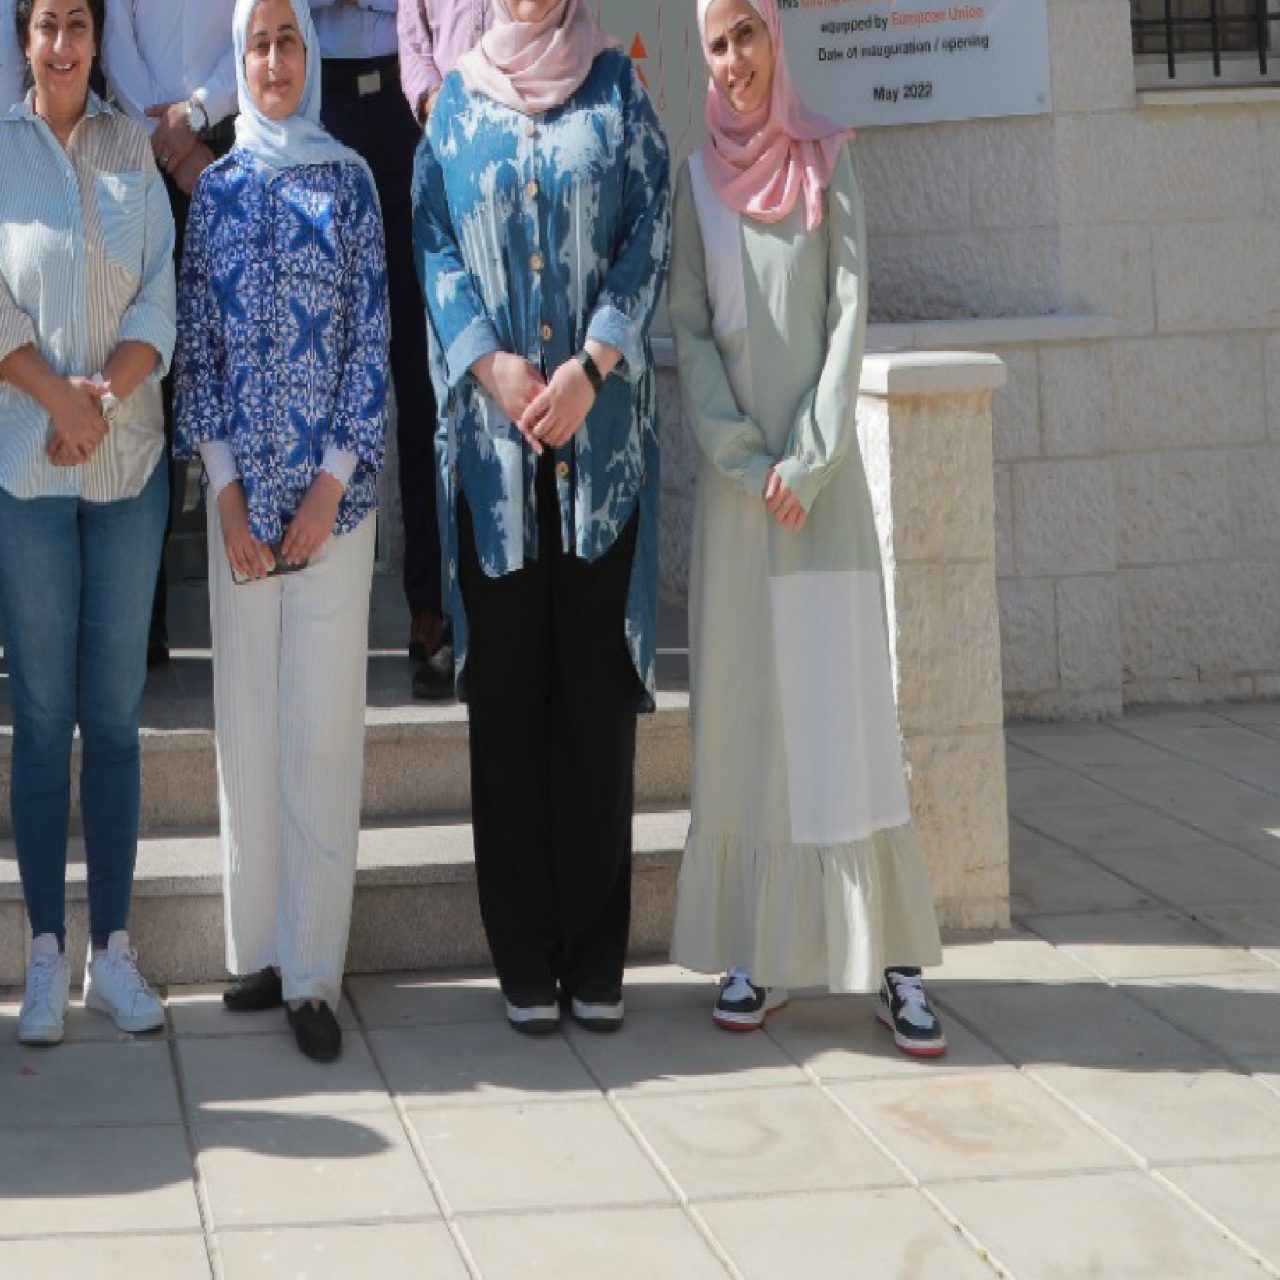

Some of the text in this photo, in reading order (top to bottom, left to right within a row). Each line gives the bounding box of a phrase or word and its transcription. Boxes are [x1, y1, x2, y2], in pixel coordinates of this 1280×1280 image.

[820, 5, 984, 35] equipped by European Union
[818, 47, 844, 62] Date
[846, 45, 858, 59] of
[861, 37, 932, 59] inauguration
[942, 34, 989, 52] opening
[873, 80, 933, 102] May 2022
